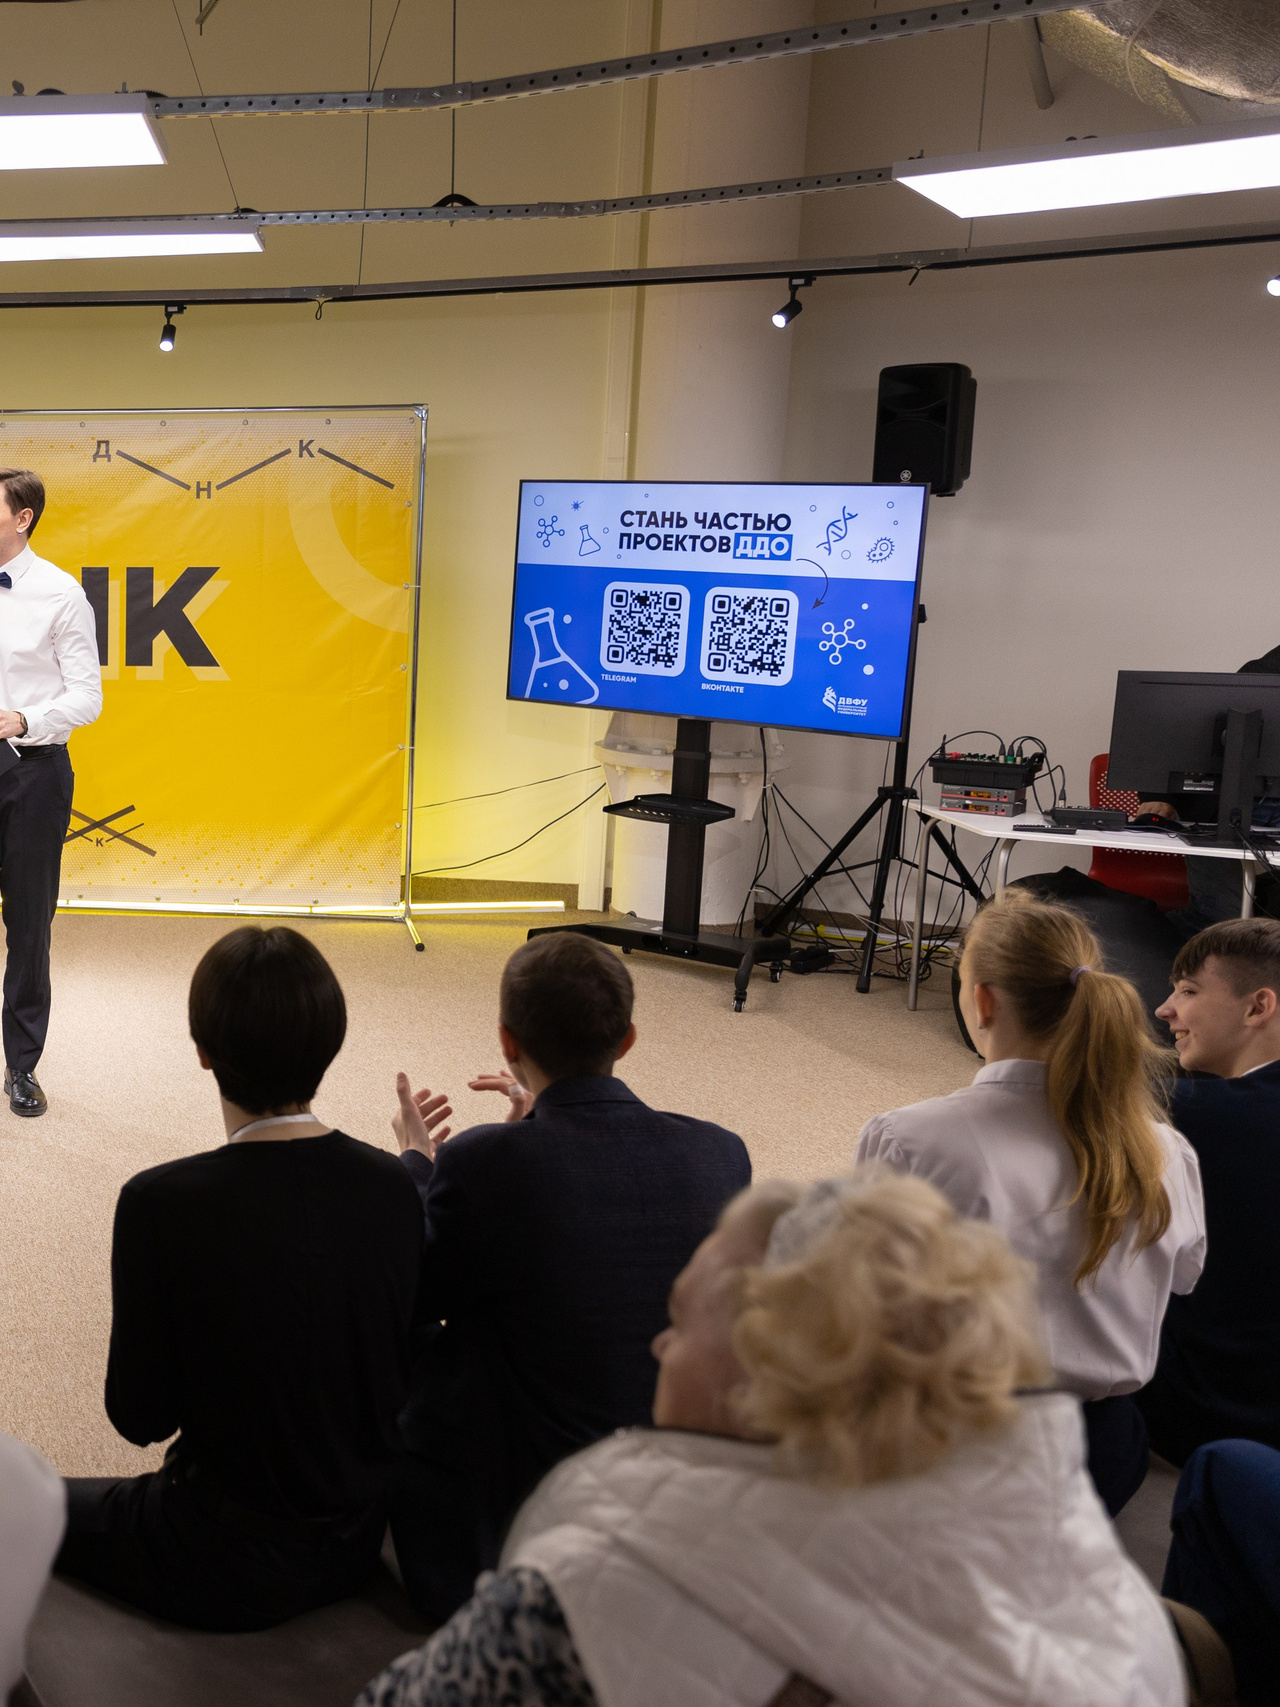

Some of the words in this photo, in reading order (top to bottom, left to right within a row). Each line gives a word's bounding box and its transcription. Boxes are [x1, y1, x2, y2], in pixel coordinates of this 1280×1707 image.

[93, 440, 111, 463] Д
[196, 481, 212, 499] Н
[298, 440, 315, 458] К
[620, 510, 688, 529] СТАНЬ
[694, 512, 792, 531] ЧАСТЬЮ
[619, 532, 731, 553] ПРОЕКТОВ
[735, 536, 790, 558] ДДО
[601, 673, 637, 683] TELEGRAM
[701, 682, 745, 694] ВКОНТАКТЕ
[838, 697, 868, 706] ДВФУ
